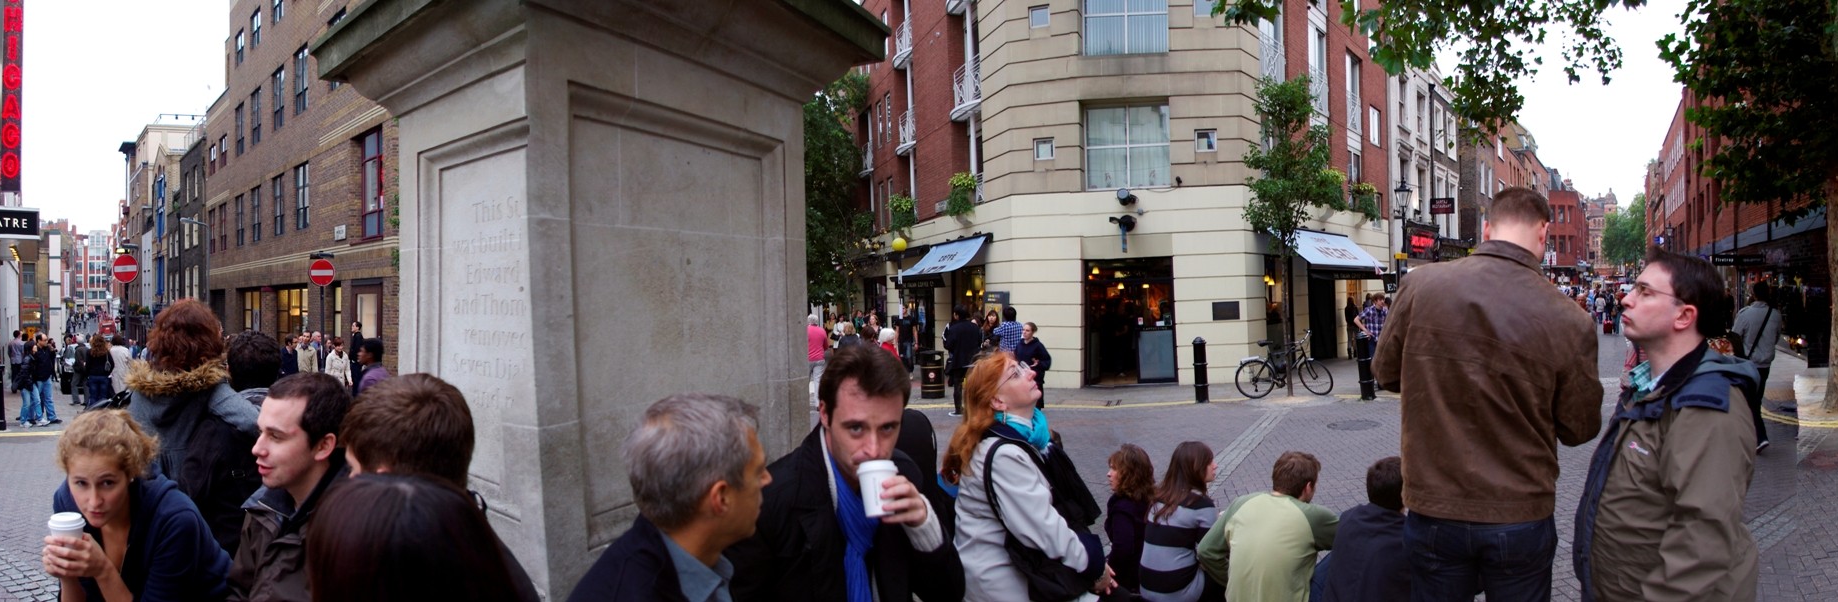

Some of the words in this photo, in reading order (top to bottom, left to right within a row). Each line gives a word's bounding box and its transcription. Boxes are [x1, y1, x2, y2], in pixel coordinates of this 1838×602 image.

[1, 0, 23, 179] HICAGO
[472, 199, 502, 223] This
[453, 238, 477, 254] was
[479, 228, 515, 253] built
[466, 260, 520, 284] Edward
[453, 293, 479, 315] and
[480, 293, 525, 316] Thom
[453, 352, 491, 378] Seven
